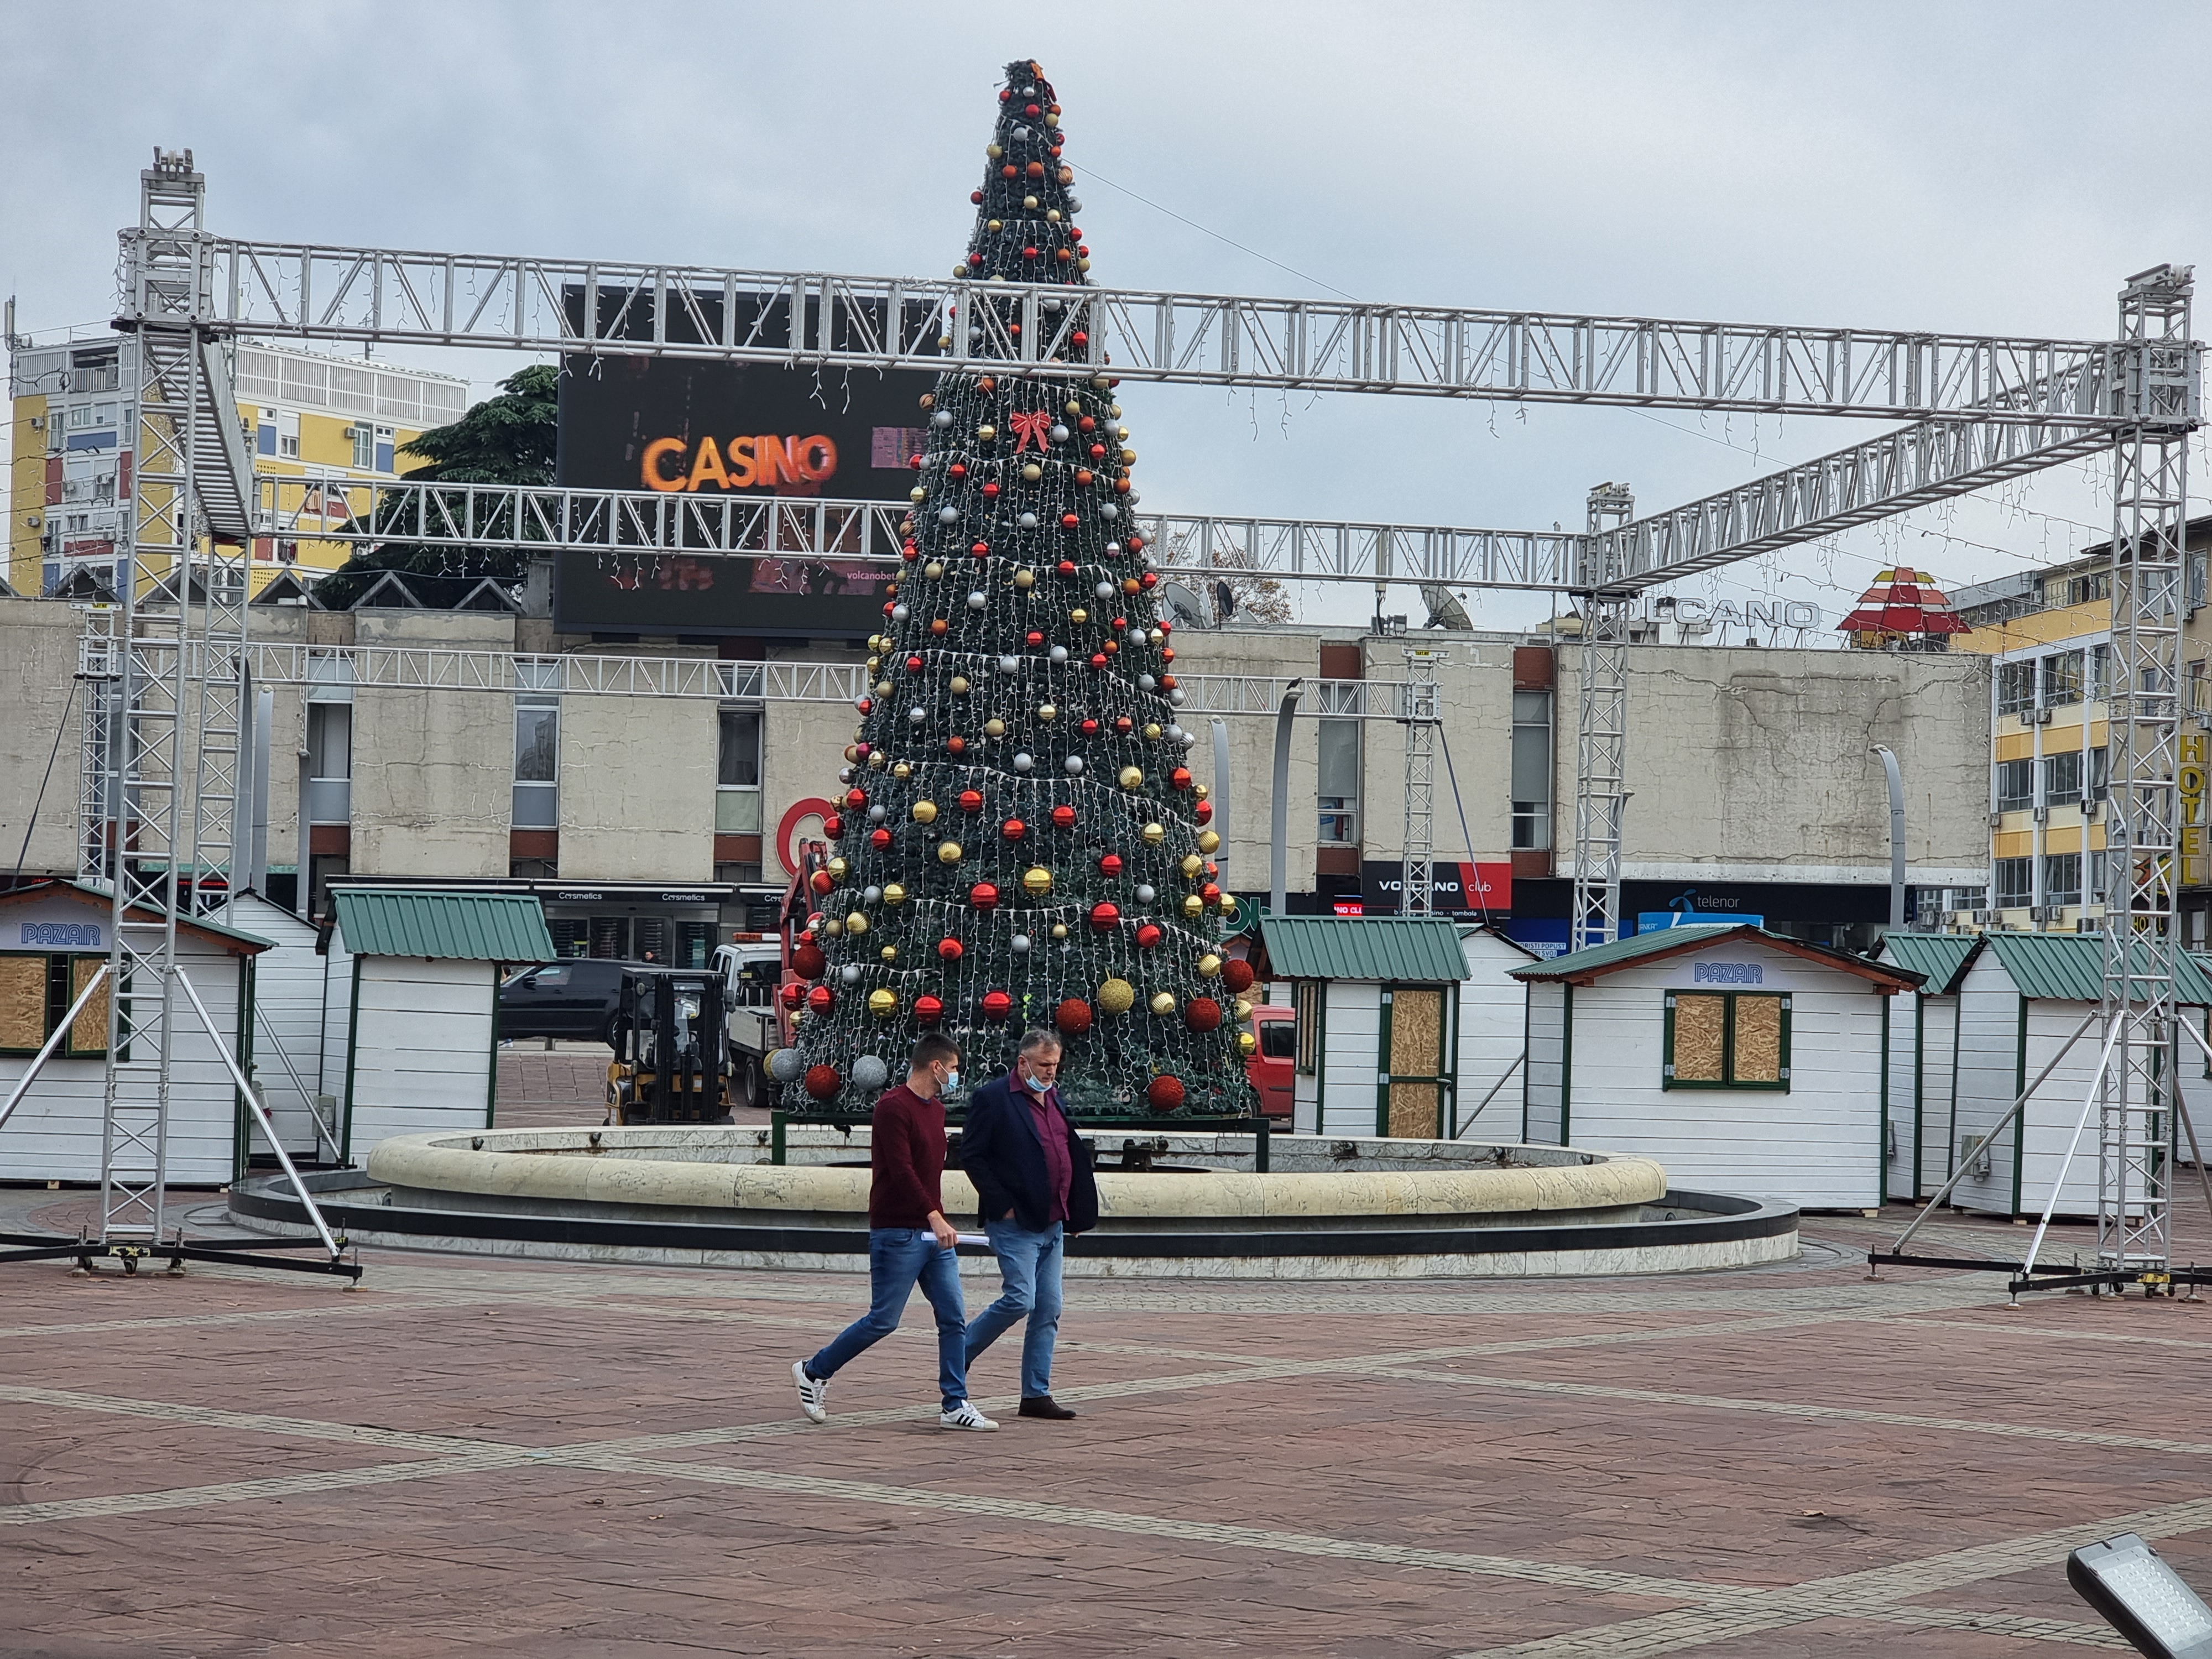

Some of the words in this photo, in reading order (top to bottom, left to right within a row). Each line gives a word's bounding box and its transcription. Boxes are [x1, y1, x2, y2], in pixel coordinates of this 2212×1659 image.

[641, 435, 837, 492] CASINO
[2179, 735, 2205, 885] HOTEL
[1468, 881, 1492, 892] club
[1697, 895, 1740, 908] telenor
[22, 923, 100, 946] PAZAR
[1695, 963, 1763, 984] PAZAR
